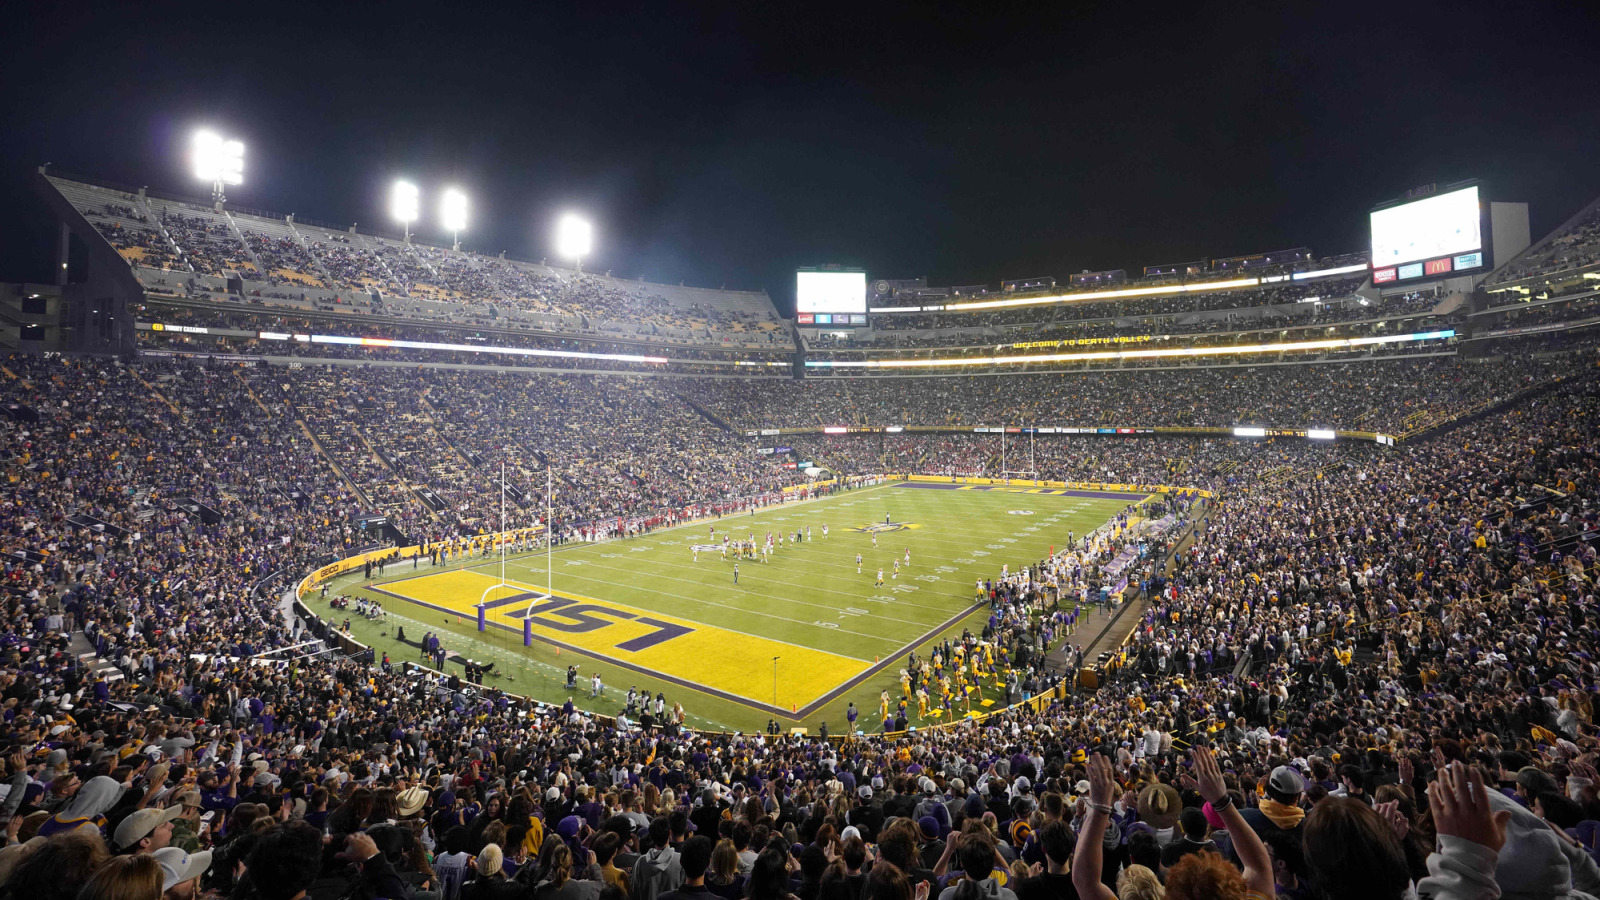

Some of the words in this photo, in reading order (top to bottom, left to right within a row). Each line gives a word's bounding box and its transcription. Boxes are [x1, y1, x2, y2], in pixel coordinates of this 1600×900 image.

[1013, 340, 1059, 349] WELCOME
[1113, 335, 1150, 343] VALLEY
[320, 565, 339, 577] GEICO
[839, 607, 869, 616] 10
[470, 591, 697, 653] LSU
